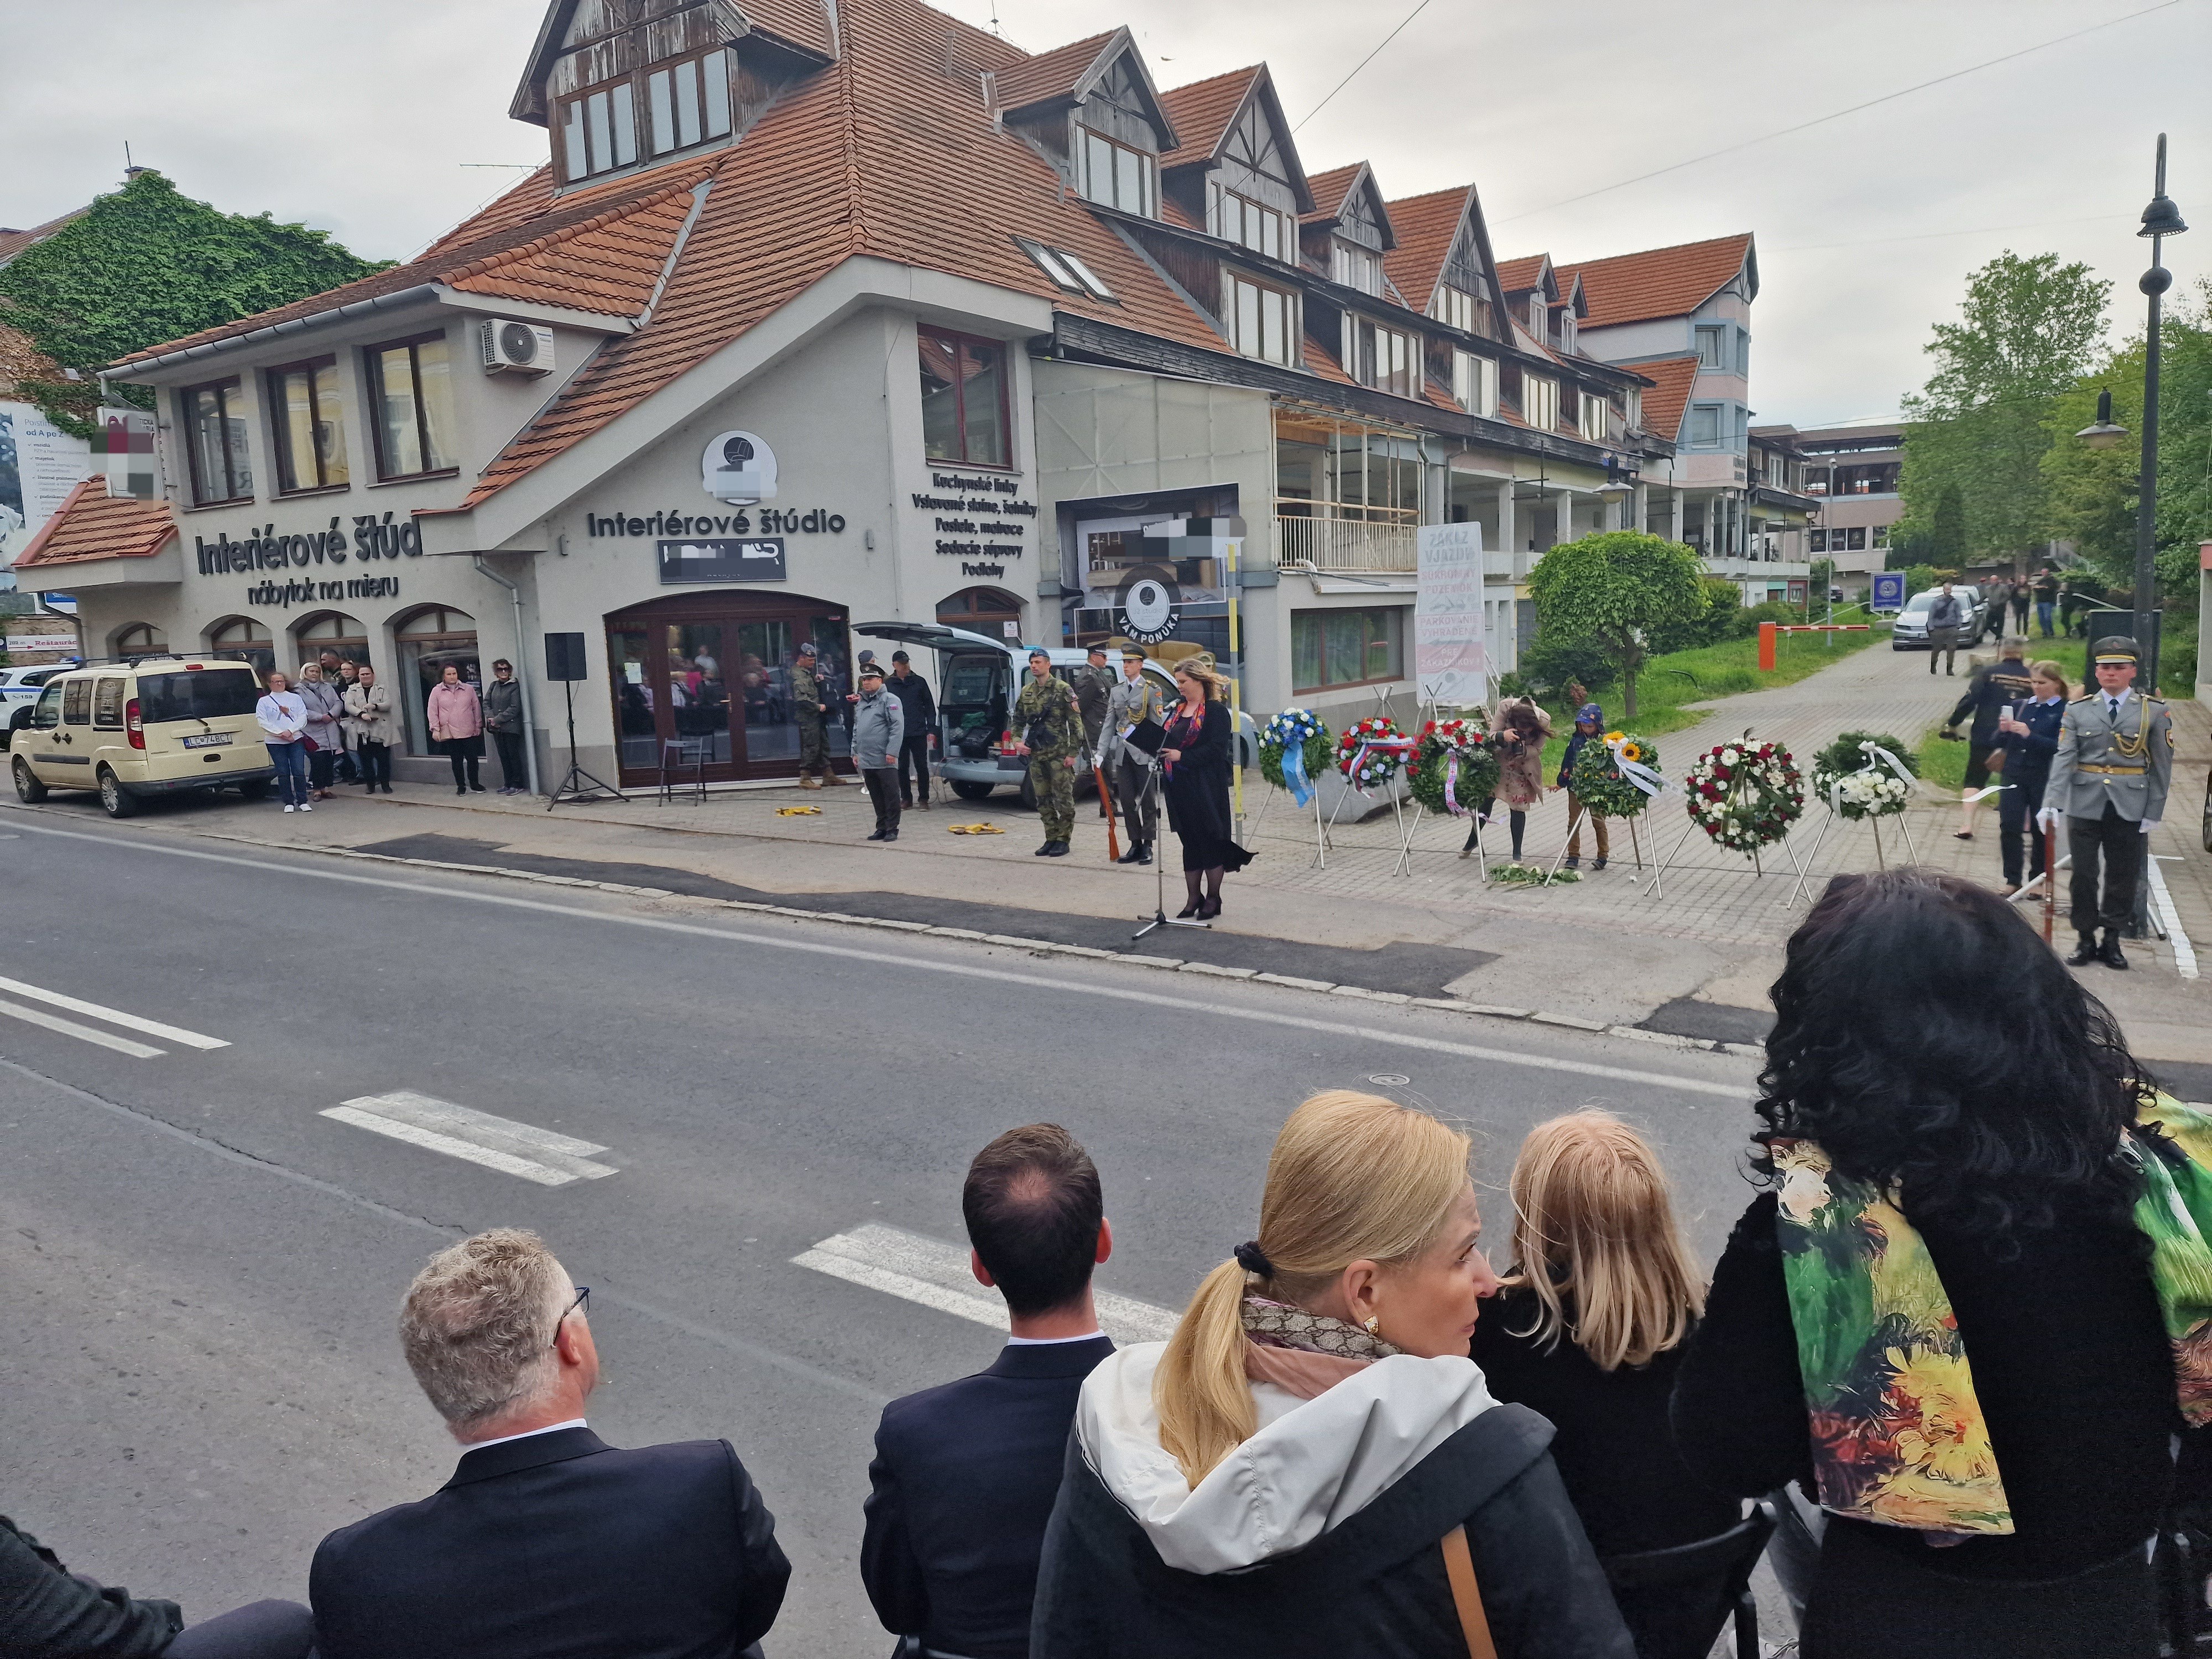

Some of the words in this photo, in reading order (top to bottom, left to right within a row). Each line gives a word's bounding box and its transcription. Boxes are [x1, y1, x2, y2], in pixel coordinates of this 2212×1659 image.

[588, 509, 751, 537] Interiérové
[759, 508, 846, 534] štúdio
[195, 517, 347, 575] Interiérové
[352, 511, 422, 561] štúd
[962, 562, 1005, 579] Podlahy
[247, 577, 317, 608] nábytok
[319, 580, 344, 601] na
[347, 573, 399, 598] mieru
[1119, 616, 1138, 640] VÁM
[1140, 613, 1180, 644] PONÚKA
